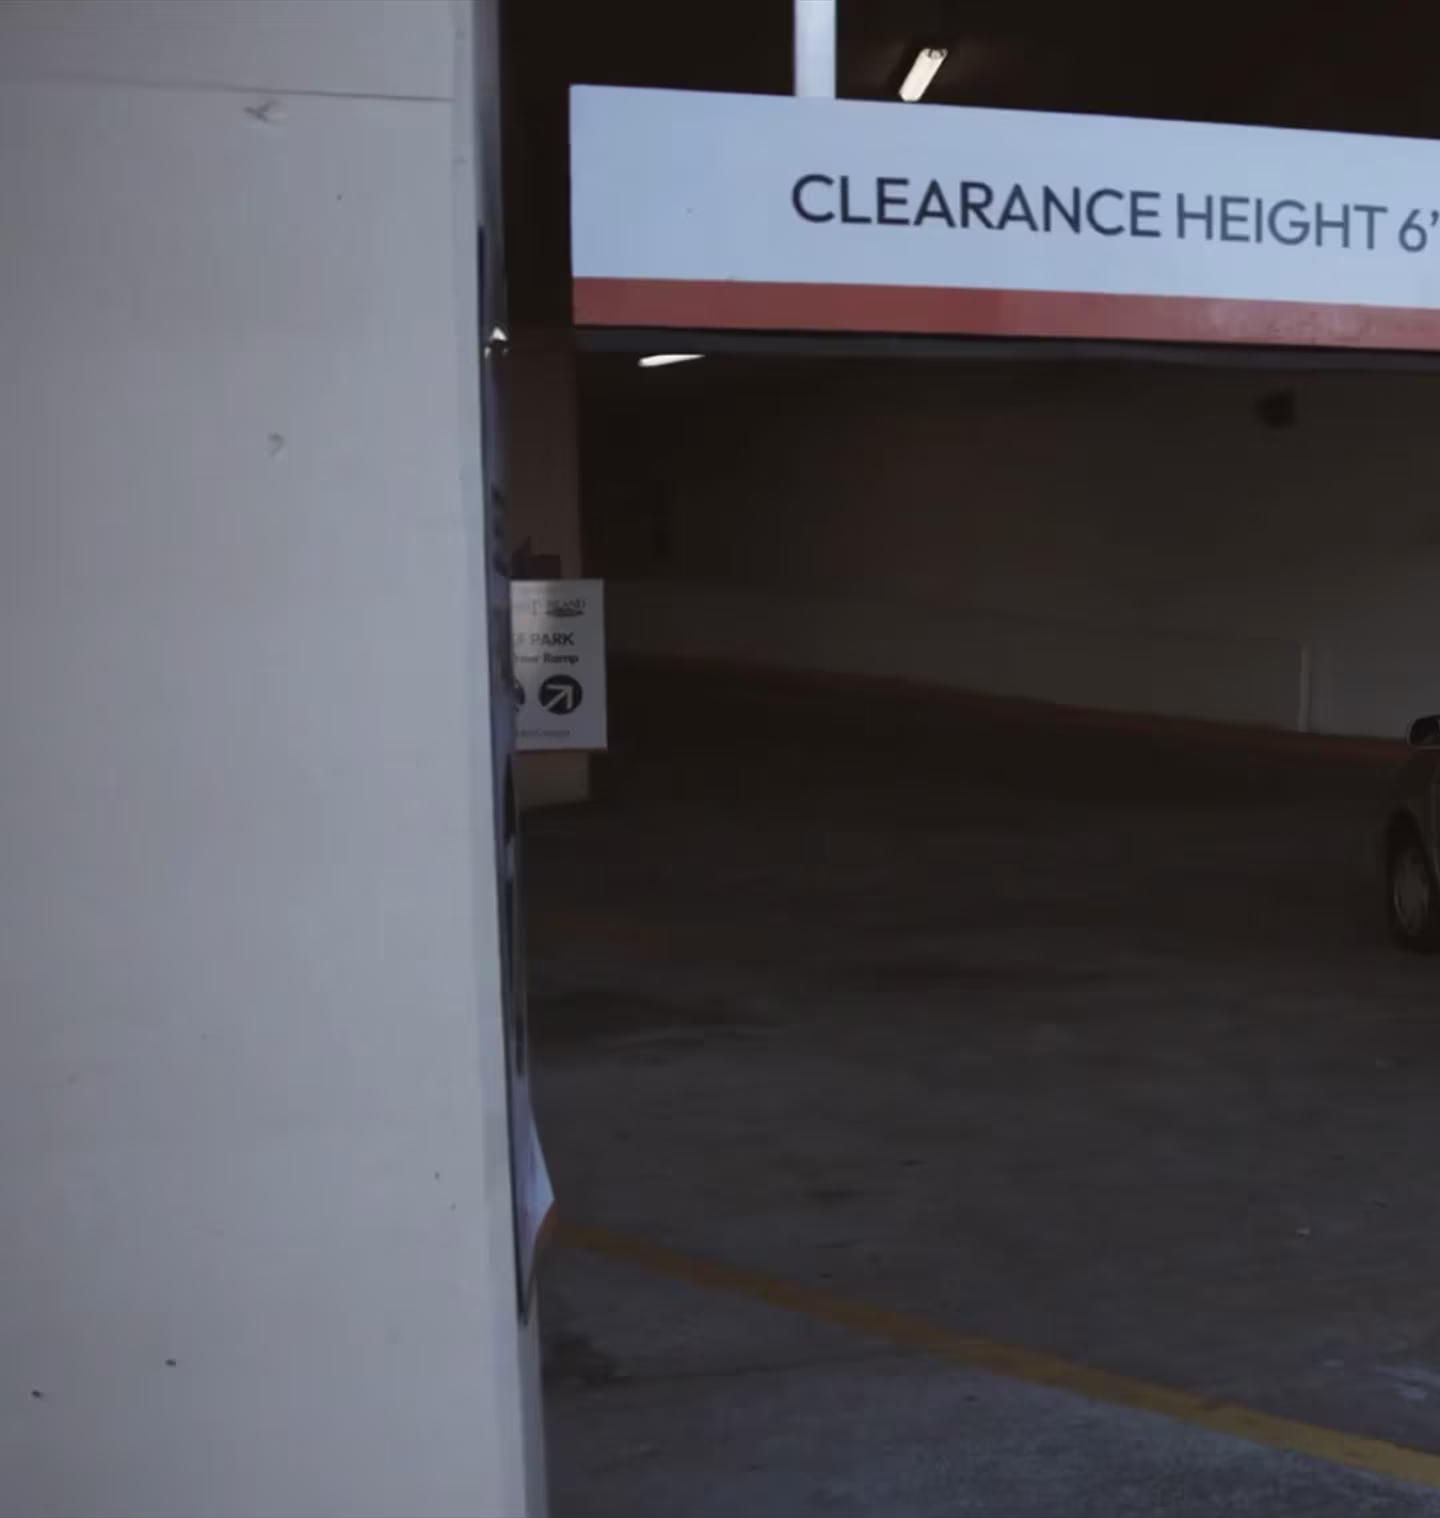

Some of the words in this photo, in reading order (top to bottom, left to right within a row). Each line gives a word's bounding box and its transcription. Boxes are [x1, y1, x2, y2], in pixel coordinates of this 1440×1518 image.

[791, 173, 1161, 238] CLEARANCE
[1176, 192, 1389, 251] HEIGHT
[530, 632, 575, 646] PARK
[543, 653, 579, 665] Ramp
